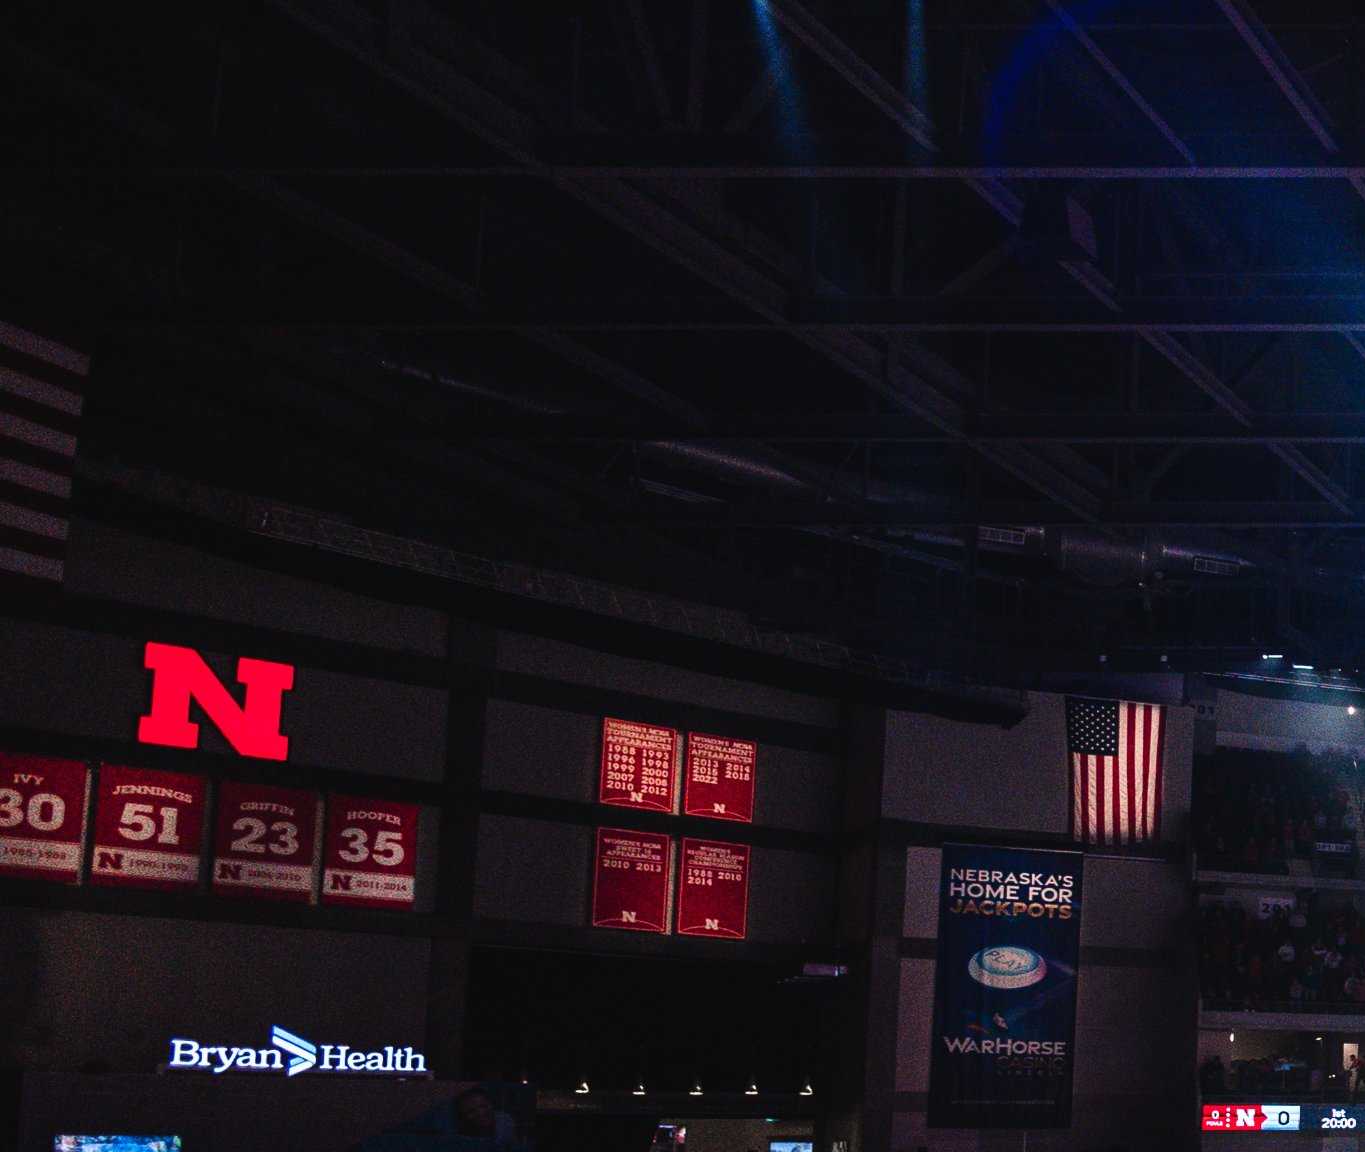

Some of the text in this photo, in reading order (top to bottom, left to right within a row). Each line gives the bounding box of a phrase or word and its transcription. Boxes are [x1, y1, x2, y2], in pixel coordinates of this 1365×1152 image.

[138, 641, 294, 761] N
[608, 752, 669, 770] 1996 1998
[642, 749, 670, 761] 1993
[607, 761, 669, 778] 1999 2000
[692, 757, 751, 774] 2013 2014
[13, 773, 45, 786] IVY
[607, 771, 635, 782] 2007
[692, 773, 719, 785] 2022
[112, 784, 193, 804] JENNINGS
[606, 780, 668, 797] 2010 2012
[117, 802, 182, 846] 51
[346, 809, 402, 827] HOOPER
[230, 817, 300, 856] 23
[338, 827, 406, 867] 35
[602, 858, 662, 873] 2010 2013
[330, 873, 352, 891] N
[951, 867, 1074, 888] NEBRASKA'S
[950, 881, 1073, 904] HOME FOR
[621, 910, 637, 924] N
[949, 898, 1073, 920] JACKPOTS
[705, 918, 720, 931] N
[170, 1037, 426, 1072] Bryan Health
[1236, 1109, 1255, 1126] N
[1278, 1111, 1289, 1125] 0
[1330, 1107, 1347, 1118] 1st
[1322, 1118, 1356, 1128] 20:00
